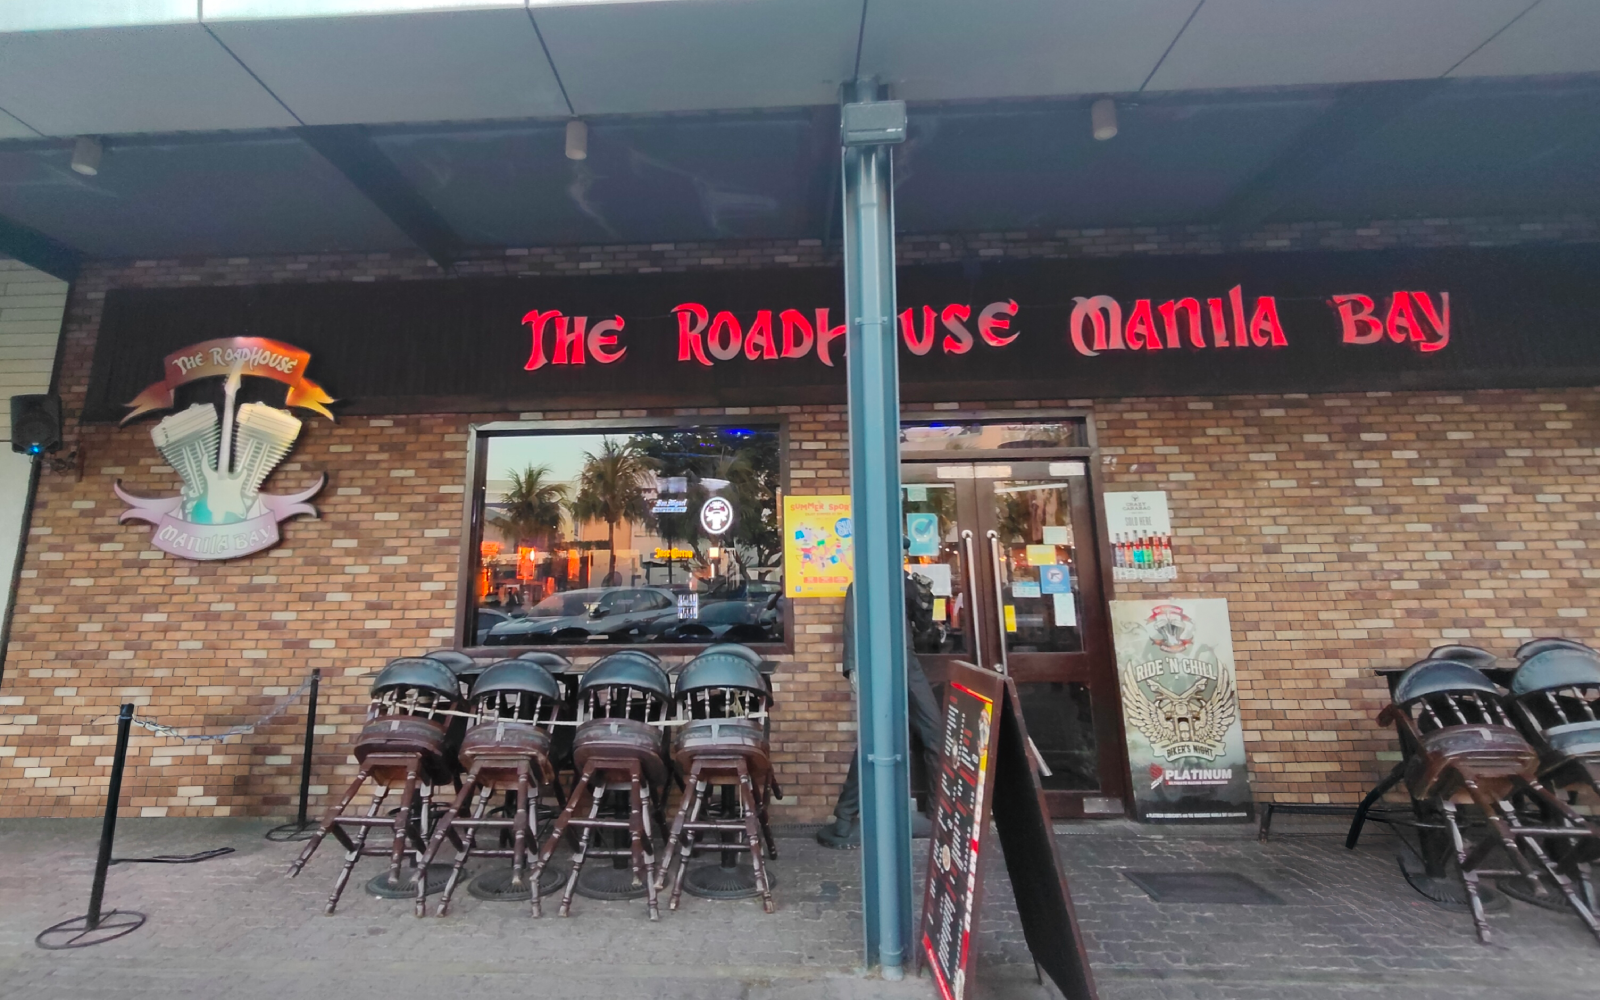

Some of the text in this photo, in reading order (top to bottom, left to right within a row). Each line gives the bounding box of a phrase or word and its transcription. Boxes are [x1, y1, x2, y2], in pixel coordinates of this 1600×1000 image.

[521, 310, 627, 371] THE
[671, 299, 1020, 367] ROADHUSE
[1329, 291, 1450, 352] BAY
[172, 346, 299, 375] THE ROADHOUSE
[790, 503, 852, 512] SUMMER SPOR
[235, 525, 273, 550] BAY
[1136, 657, 1217, 682] RIDE 'N CHILL
[1167, 739, 1213, 758] BIKER'S NIGHT
[1165, 768, 1232, 780] PLATINUM
